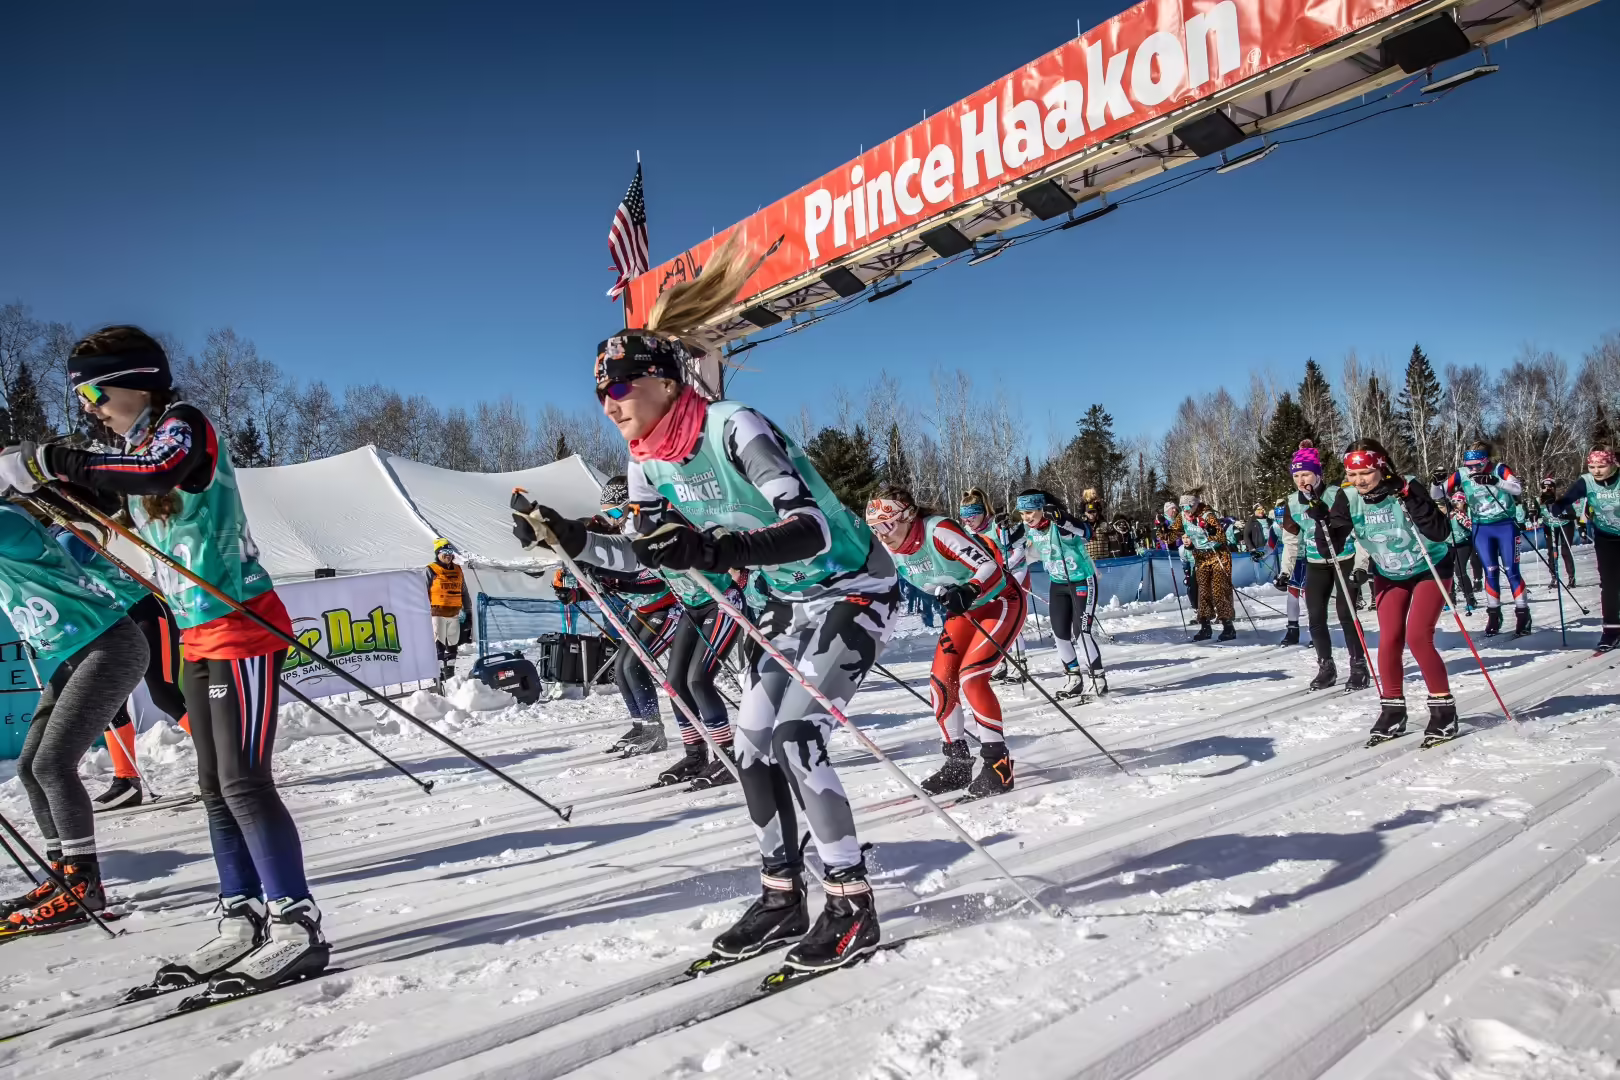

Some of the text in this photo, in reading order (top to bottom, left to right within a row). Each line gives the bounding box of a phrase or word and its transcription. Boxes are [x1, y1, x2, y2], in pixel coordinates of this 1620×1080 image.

[803, 0, 1241, 261] Prince Haakon
[673, 480, 723, 503] BIRKIE
[321, 605, 402, 659] Deli
[364, 654, 372, 662] &
[373, 654, 399, 663] MORE
[835, 920, 861, 955] ATOMIC
